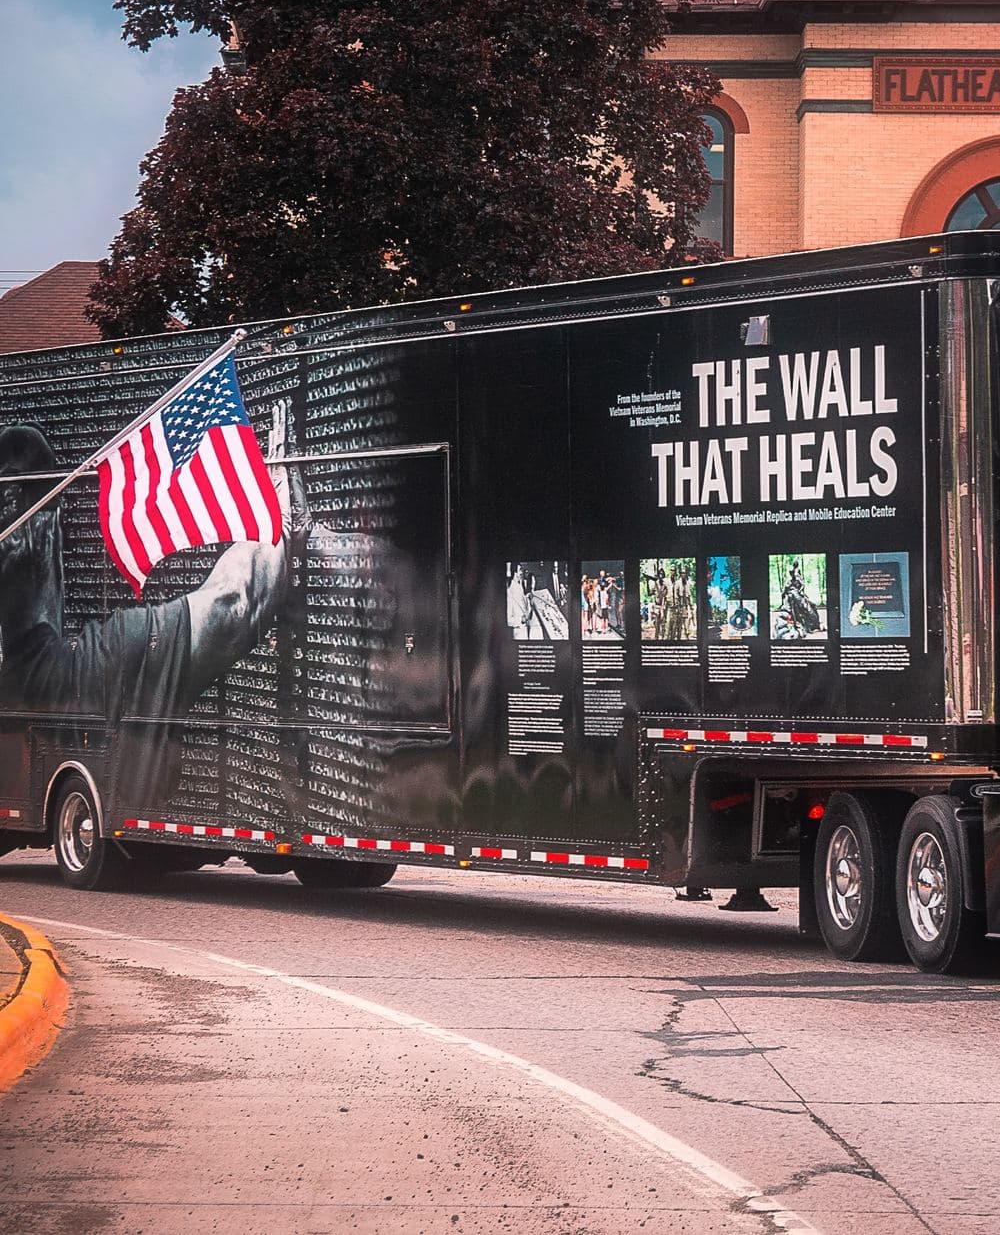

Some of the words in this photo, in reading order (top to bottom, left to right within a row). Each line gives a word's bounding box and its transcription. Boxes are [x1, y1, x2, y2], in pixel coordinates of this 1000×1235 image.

[692, 356, 771, 428] THE
[778, 344, 899, 422] WALL
[617, 394, 631, 405] From
[631, 393, 641, 403] the
[665, 390, 672, 400] of
[672, 389, 681, 399] the
[609, 406, 631, 417] Vietnam
[631, 405, 656, 415] Veterans
[656, 401, 682, 413] Memorial
[669, 413, 682, 424] D.C.
[651, 436, 749, 508] THAT
[759, 426, 898, 502] HEALS
[675, 514, 703, 526] Vietnam
[703, 513, 732, 525] Veterans
[733, 511, 765, 524] Memorial
[766, 509, 793, 525] Replica
[794, 508, 807, 522] and
[808, 507, 833, 521] Mobile
[833, 506, 870, 520] Education
[871, 504, 897, 518] Center
